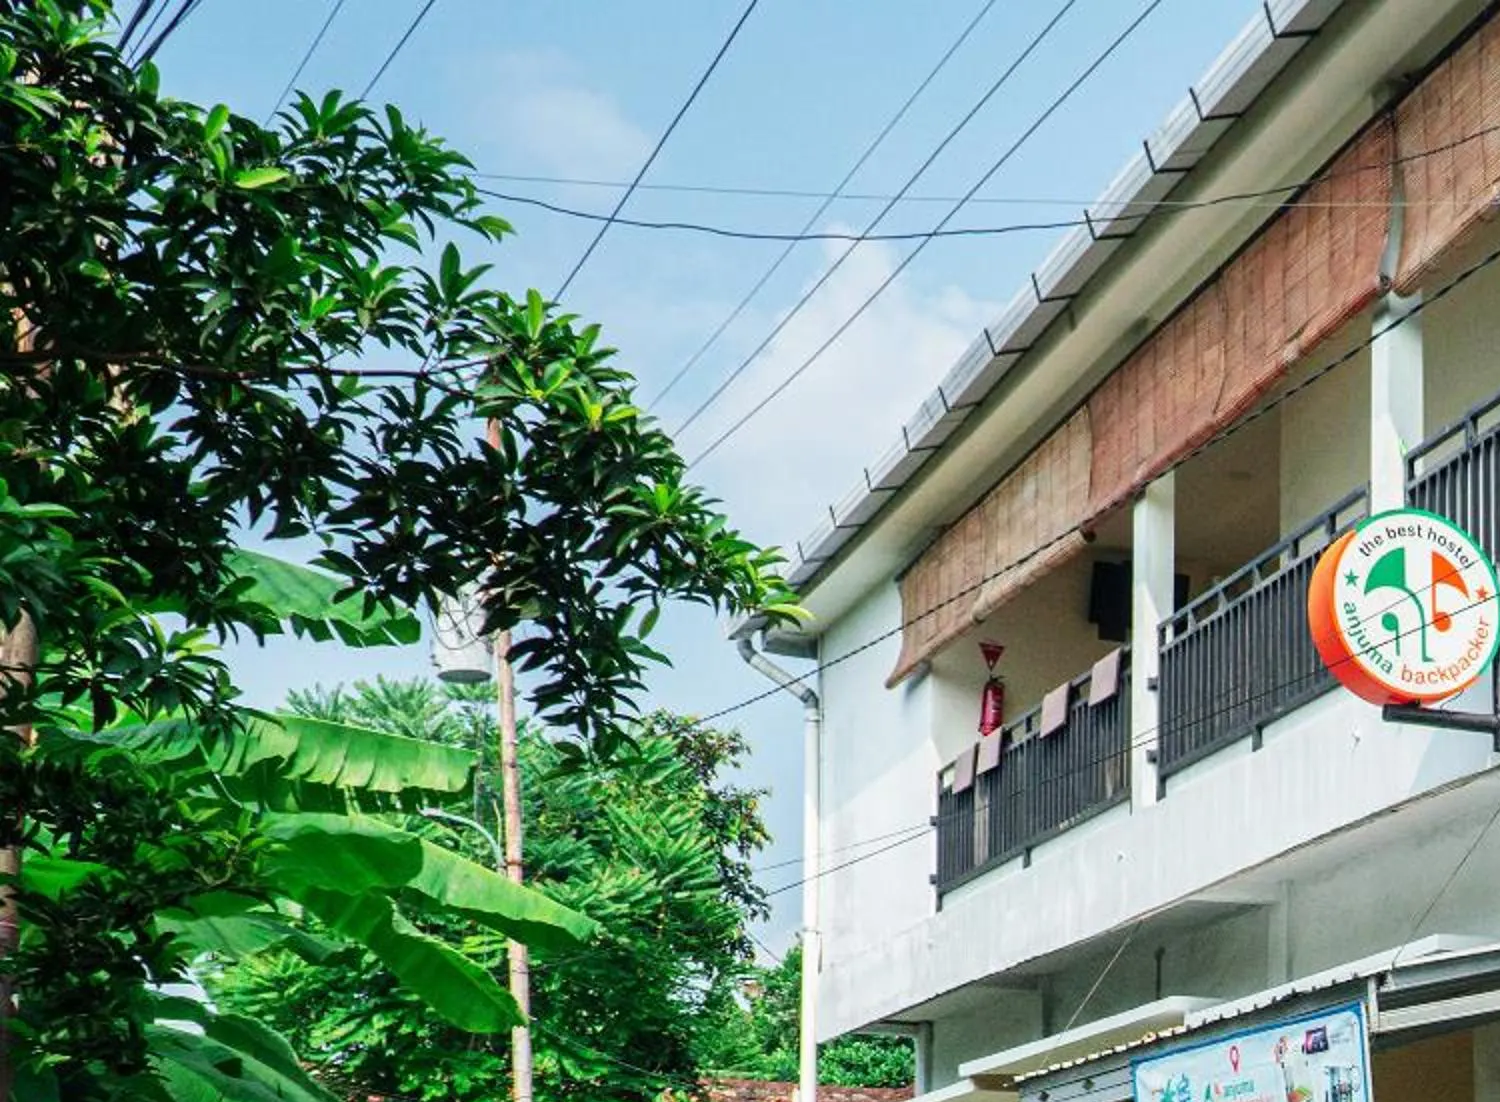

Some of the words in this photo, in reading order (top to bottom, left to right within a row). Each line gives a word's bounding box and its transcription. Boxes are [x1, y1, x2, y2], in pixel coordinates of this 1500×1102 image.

[1358, 534, 1385, 557] the
[1385, 524, 1423, 539] best
[1427, 527, 1476, 569] hostel
[1343, 601, 1393, 674] anjuma
[1401, 615, 1490, 685] backpacker
